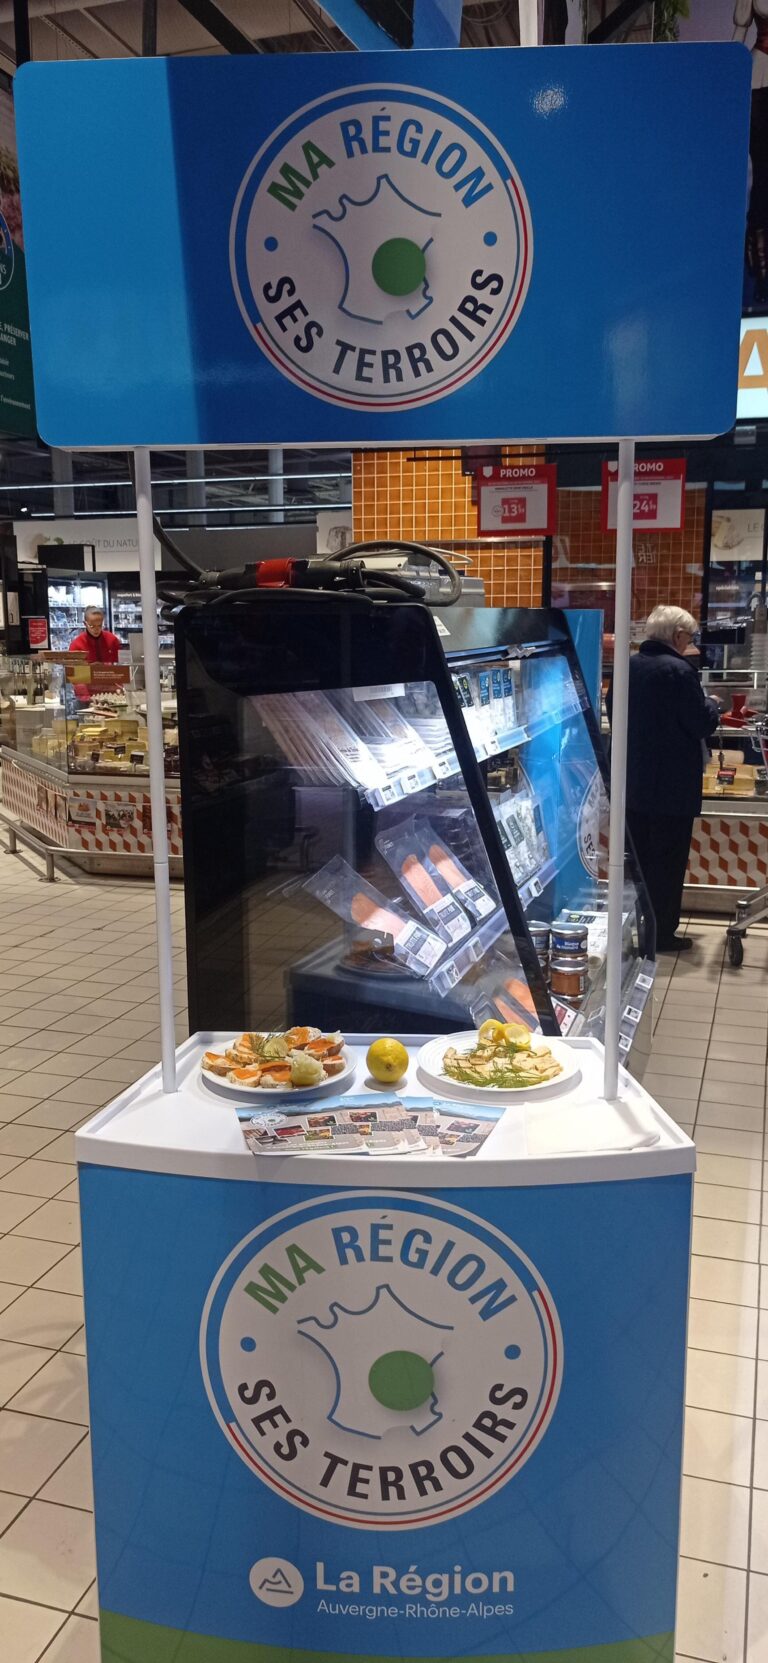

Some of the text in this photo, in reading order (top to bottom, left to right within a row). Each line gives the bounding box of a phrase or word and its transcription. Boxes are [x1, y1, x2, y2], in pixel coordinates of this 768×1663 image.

[267, 107, 494, 212] MA RÉGION
[263, 269, 505, 384] SES TERROIRS
[500, 468, 536, 478] PROMO
[634, 462, 664, 472] ROMO
[103, 539, 114, 548] DU
[116, 539, 138, 547] NATU
[243, 1215, 518, 1322] MA RÉGION
[237, 1379, 529, 1501] SES TERROIRS
[316, 1561, 515, 1602] La Région
[317, 1600, 514, 1620] Auvergne-Rhône-Alpes
